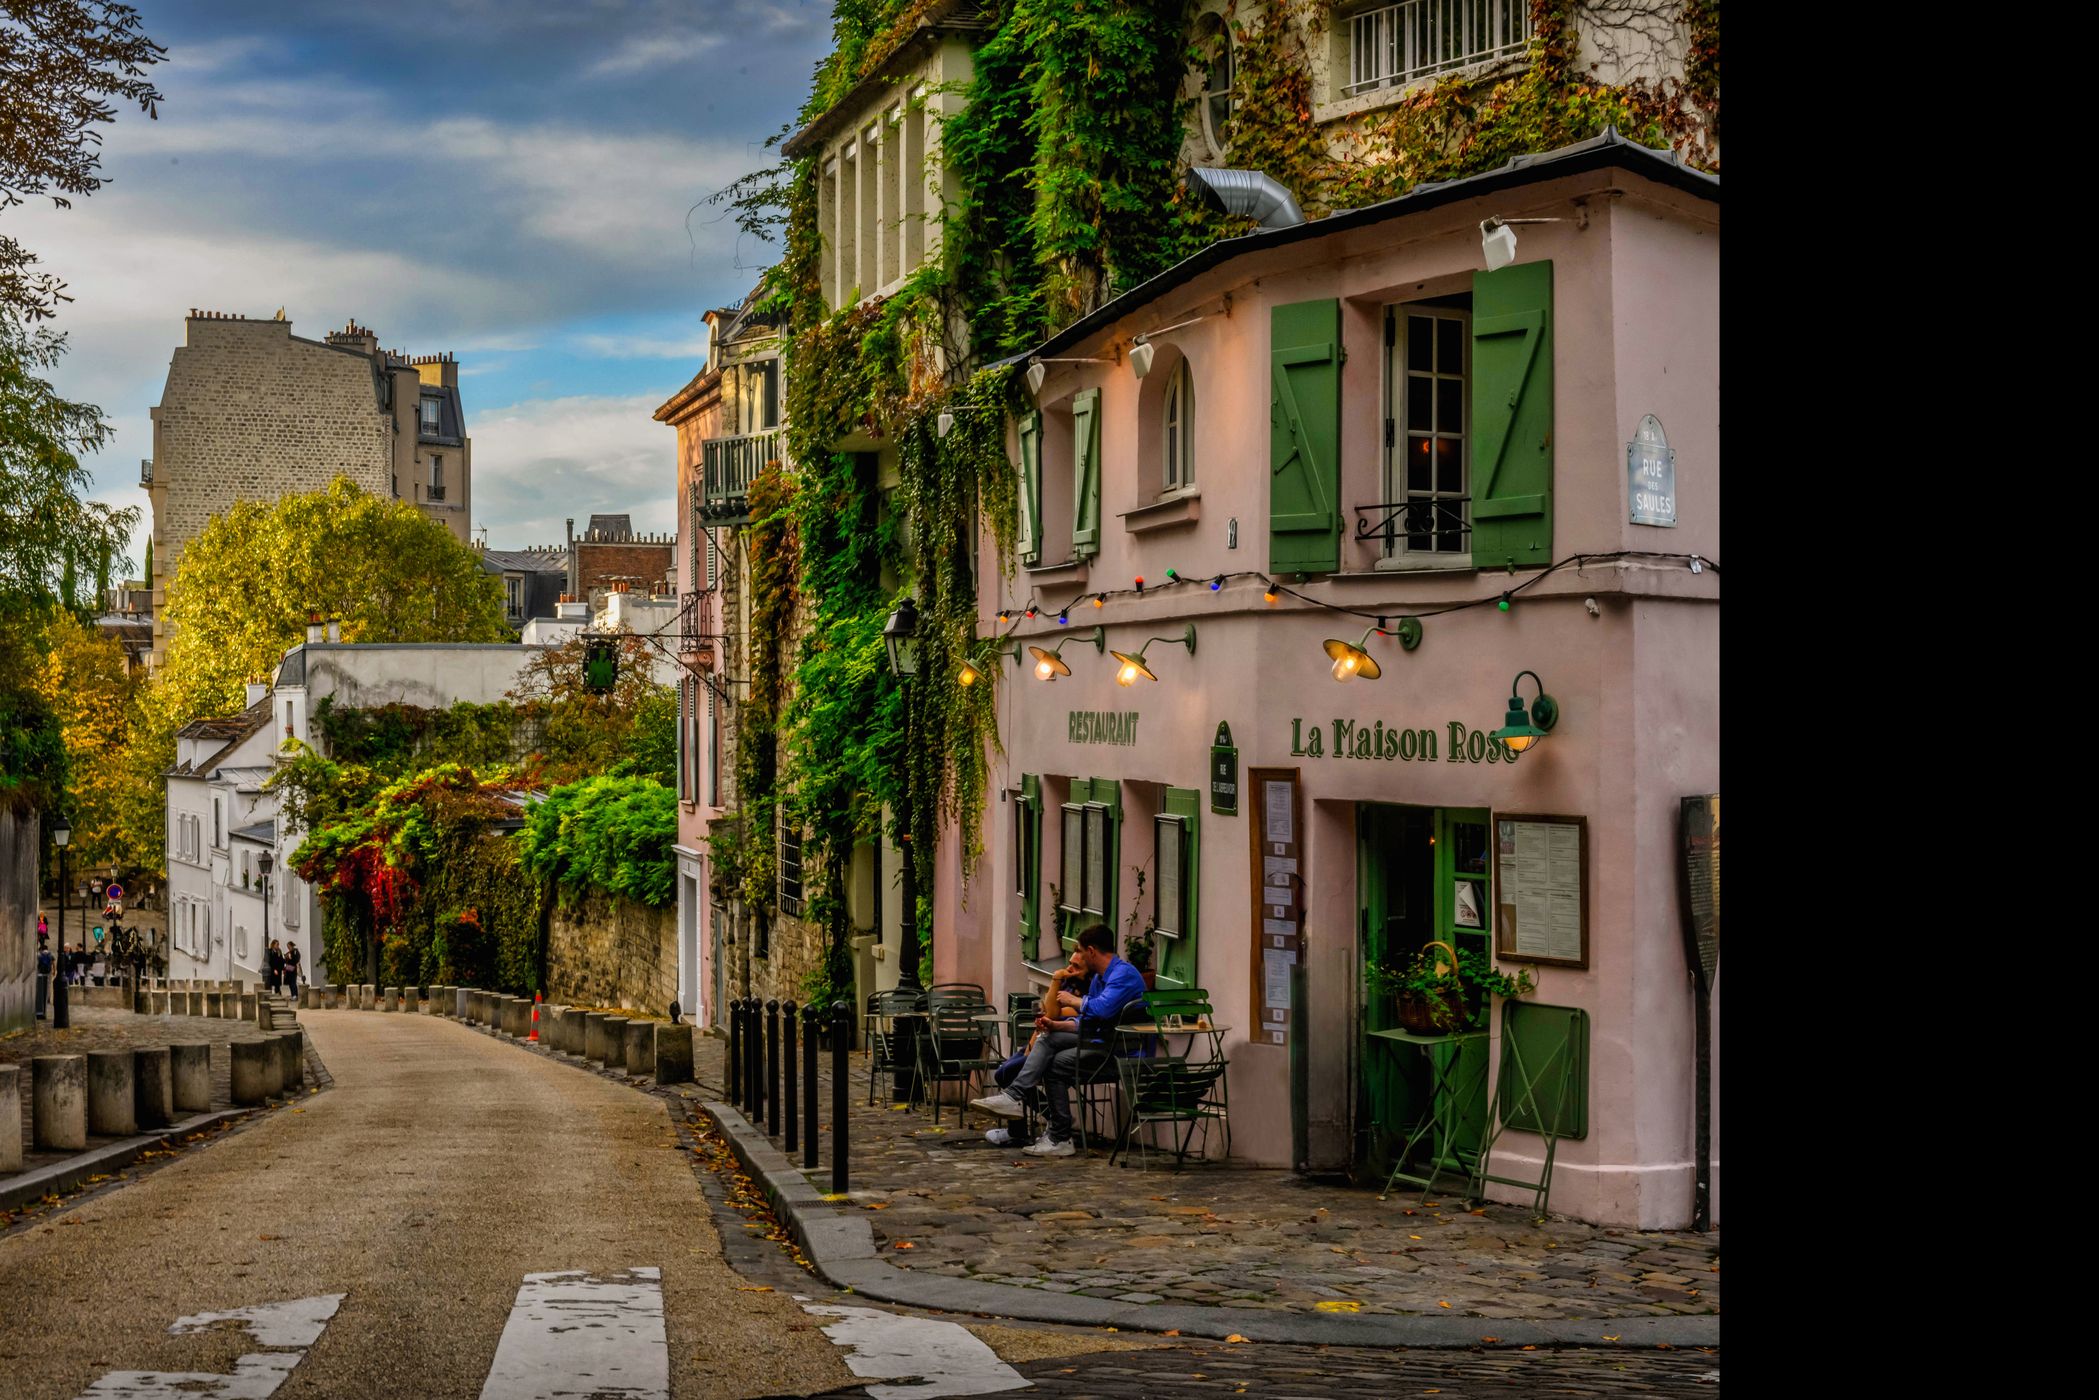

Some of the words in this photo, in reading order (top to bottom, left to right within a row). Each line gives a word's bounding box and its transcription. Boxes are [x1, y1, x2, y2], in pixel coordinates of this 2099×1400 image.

[1643, 459, 1662, 478] RUE
[1647, 481, 1658, 491] DES
[1636, 493, 1671, 514] SAULES
[1068, 711, 1139, 746] RESTAURANT
[1291, 718, 1324, 758] La
[1332, 719, 1438, 761] Maison
